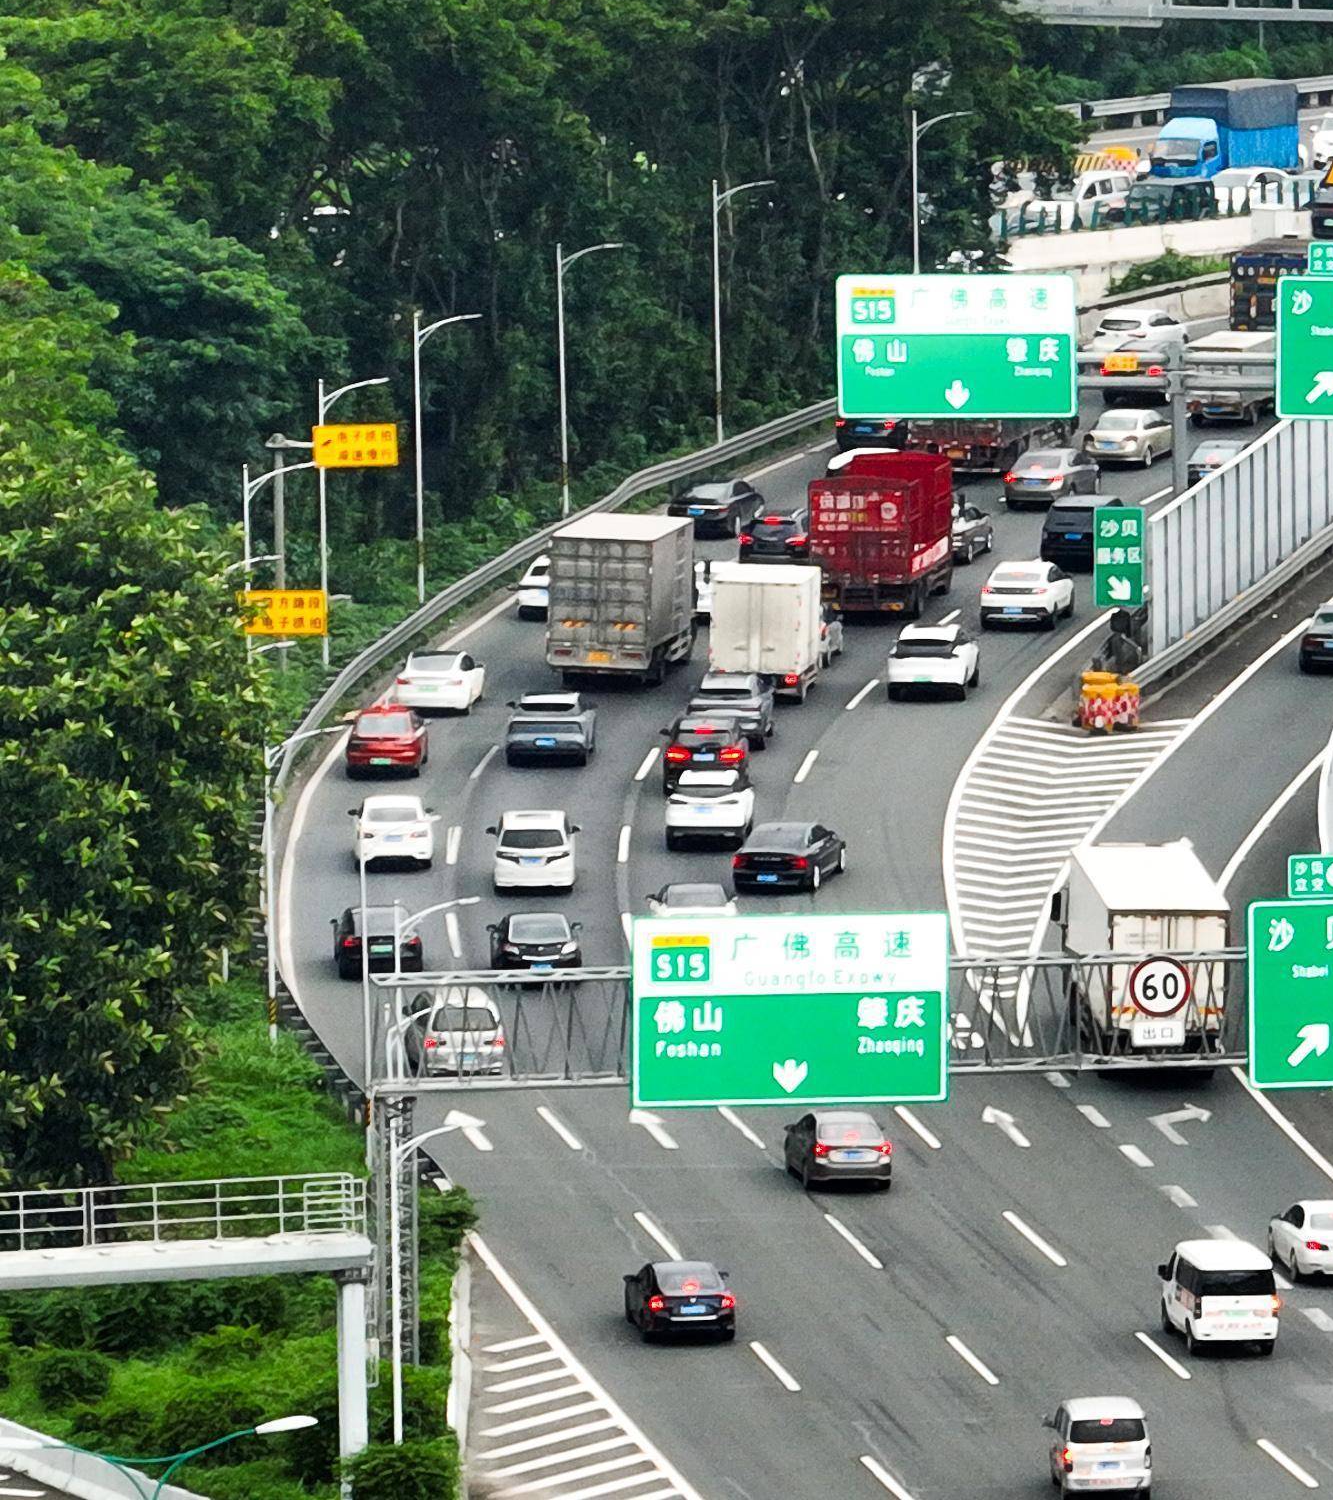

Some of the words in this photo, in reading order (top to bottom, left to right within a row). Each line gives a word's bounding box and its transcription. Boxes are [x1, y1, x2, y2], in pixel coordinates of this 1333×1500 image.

[911, 287, 1049, 310] 广佛高速
[853, 299, 892, 321] S15
[852, 337, 908, 363] 佛山
[1100, 518, 1138, 538] 沙贝
[1097, 546, 1142, 565] 服务区
[731, 930, 912, 961] 广佛高速
[655, 952, 706, 979] S15
[1291, 963, 1329, 978] Shabei
[1141, 972, 1179, 1000] 60
[653, 1000, 723, 1033] 佛山
[856, 996, 927, 1029] 肇庆
[1142, 1026, 1174, 1040] 出口
[655, 1040, 722, 1058] Foshan
[857, 1036, 925, 1058] Zhaoqing
